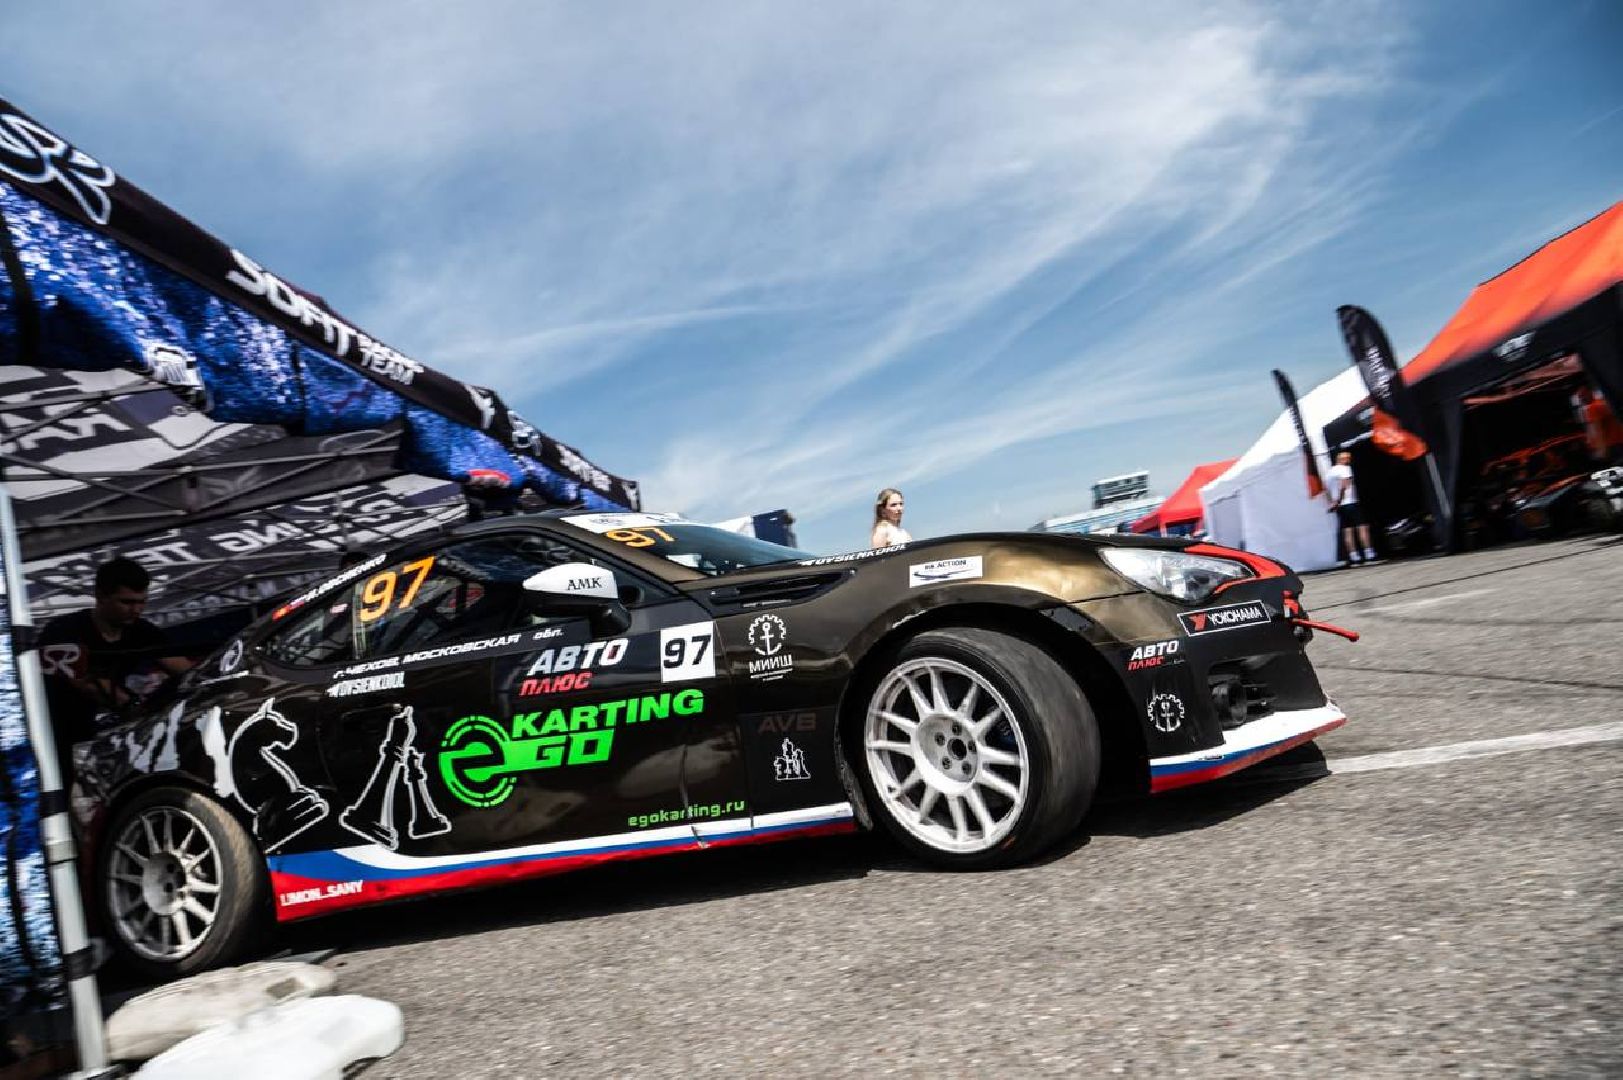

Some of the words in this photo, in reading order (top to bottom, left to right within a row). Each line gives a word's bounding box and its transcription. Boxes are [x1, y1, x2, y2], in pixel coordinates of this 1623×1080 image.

[604, 526, 675, 548] 97
[359, 555, 436, 622] 97
[1207, 606, 1263, 627] YOKOHAMA
[526, 637, 629, 676] АВТО
[663, 634, 712, 669] 97
[1131, 640, 1180, 661] АВТО
[519, 671, 594, 696] ПЛЮС
[512, 689, 704, 738] KARTING
[628, 800, 745, 827] egokarting.ru
